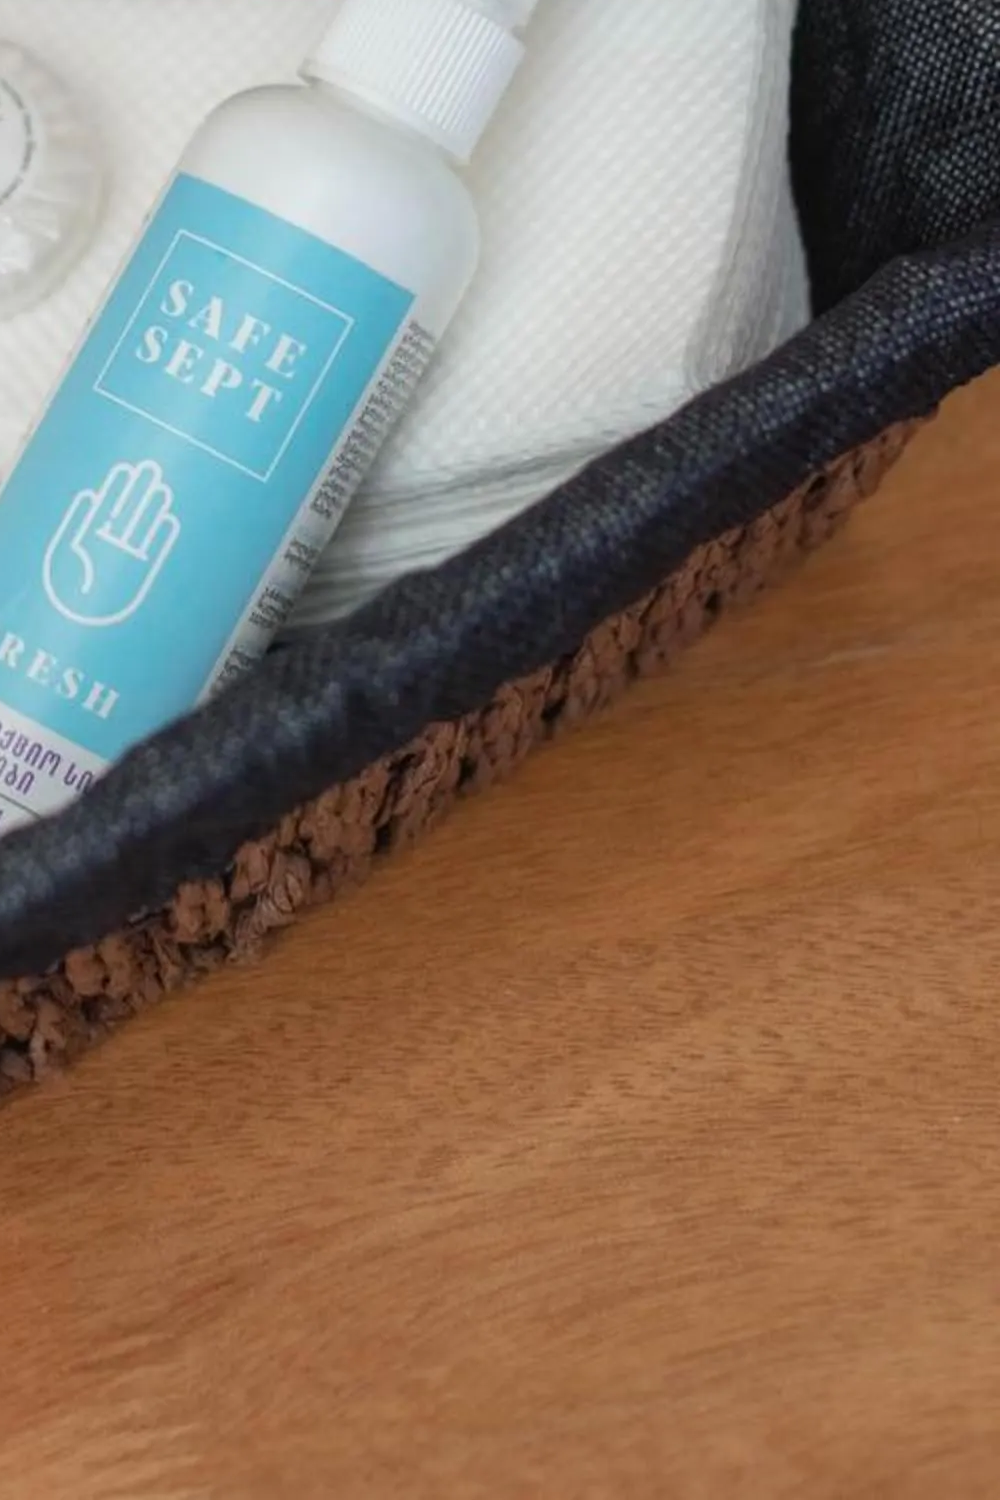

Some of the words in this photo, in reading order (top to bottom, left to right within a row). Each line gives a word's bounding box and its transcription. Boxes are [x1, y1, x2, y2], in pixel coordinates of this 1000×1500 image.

[135, 324, 284, 423] SEPT
[159, 278, 308, 379] SAFE
[62, 761, 95, 795] სი
